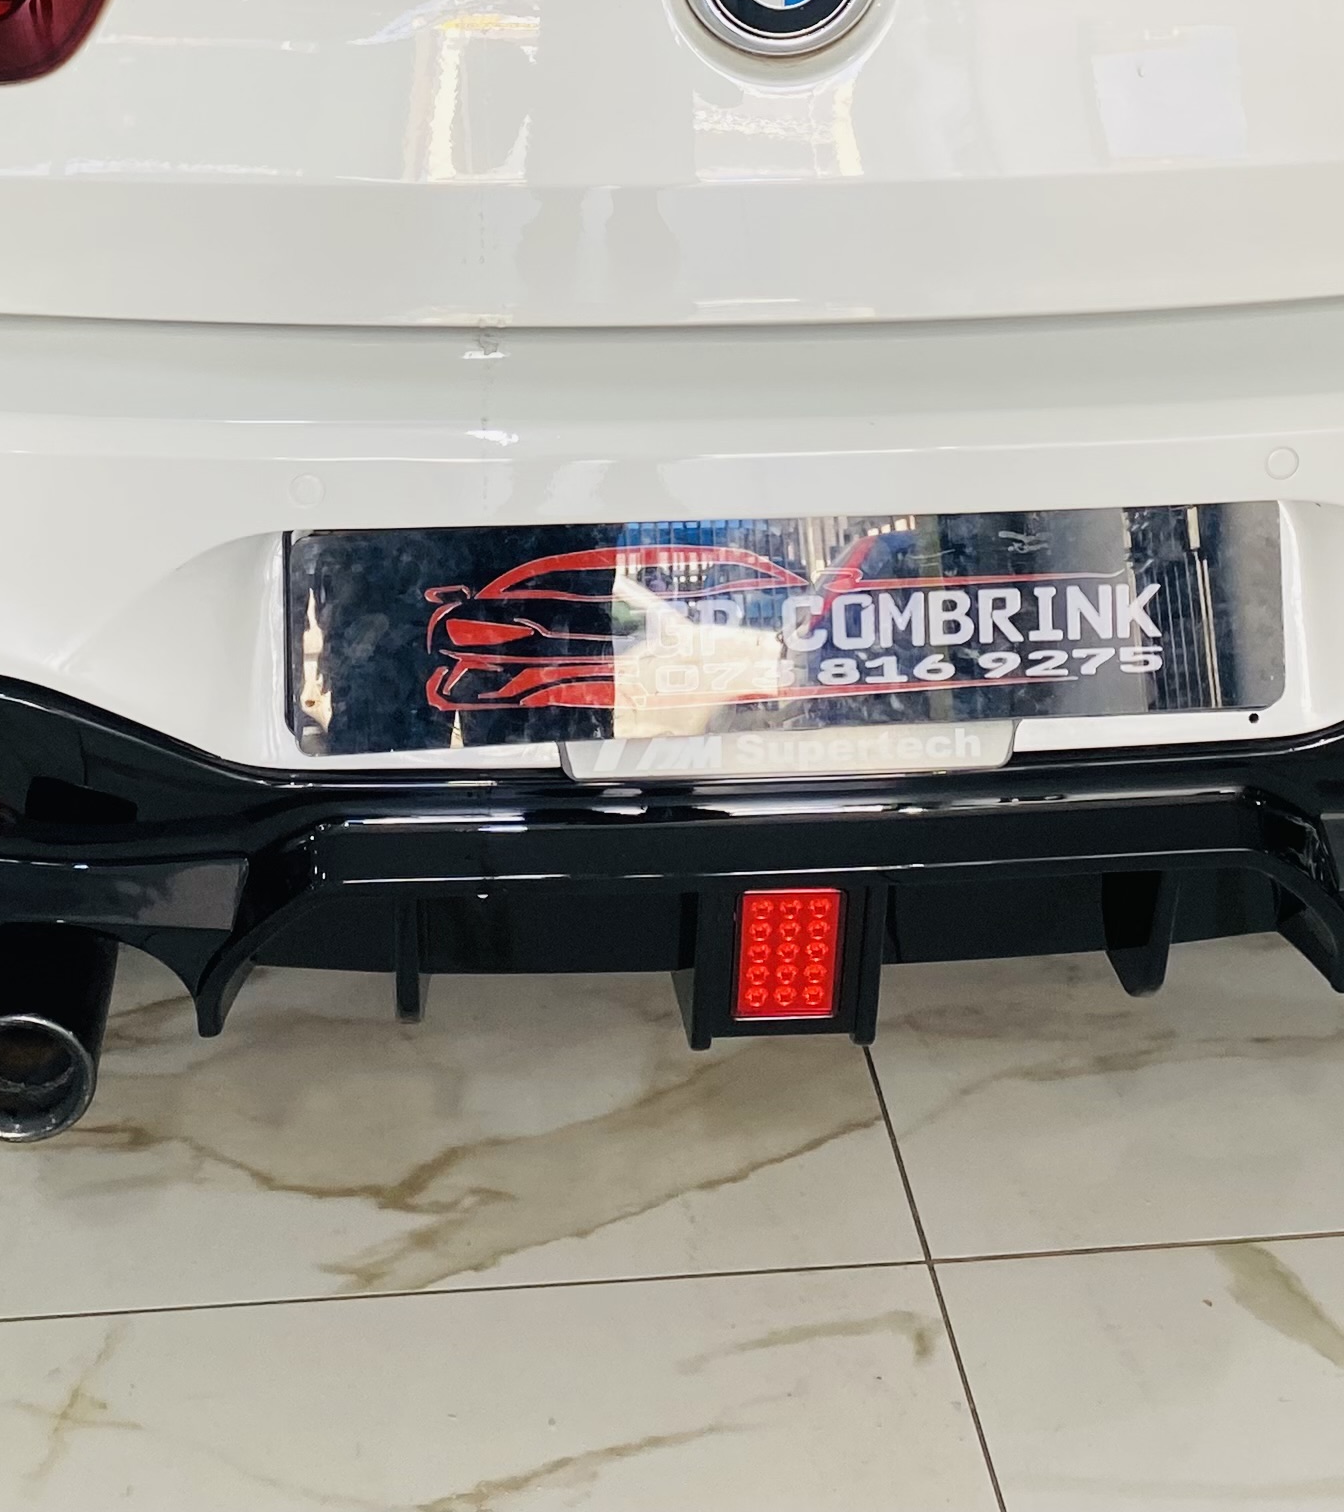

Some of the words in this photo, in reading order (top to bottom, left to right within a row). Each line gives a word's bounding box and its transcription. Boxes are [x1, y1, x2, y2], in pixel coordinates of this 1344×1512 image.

[645, 598, 743, 659] GP
[781, 584, 1162, 652] COMBRINK
[817, 653, 957, 685] 816
[977, 646, 1163, 680] 9275
[735, 727, 983, 768] Supertech
